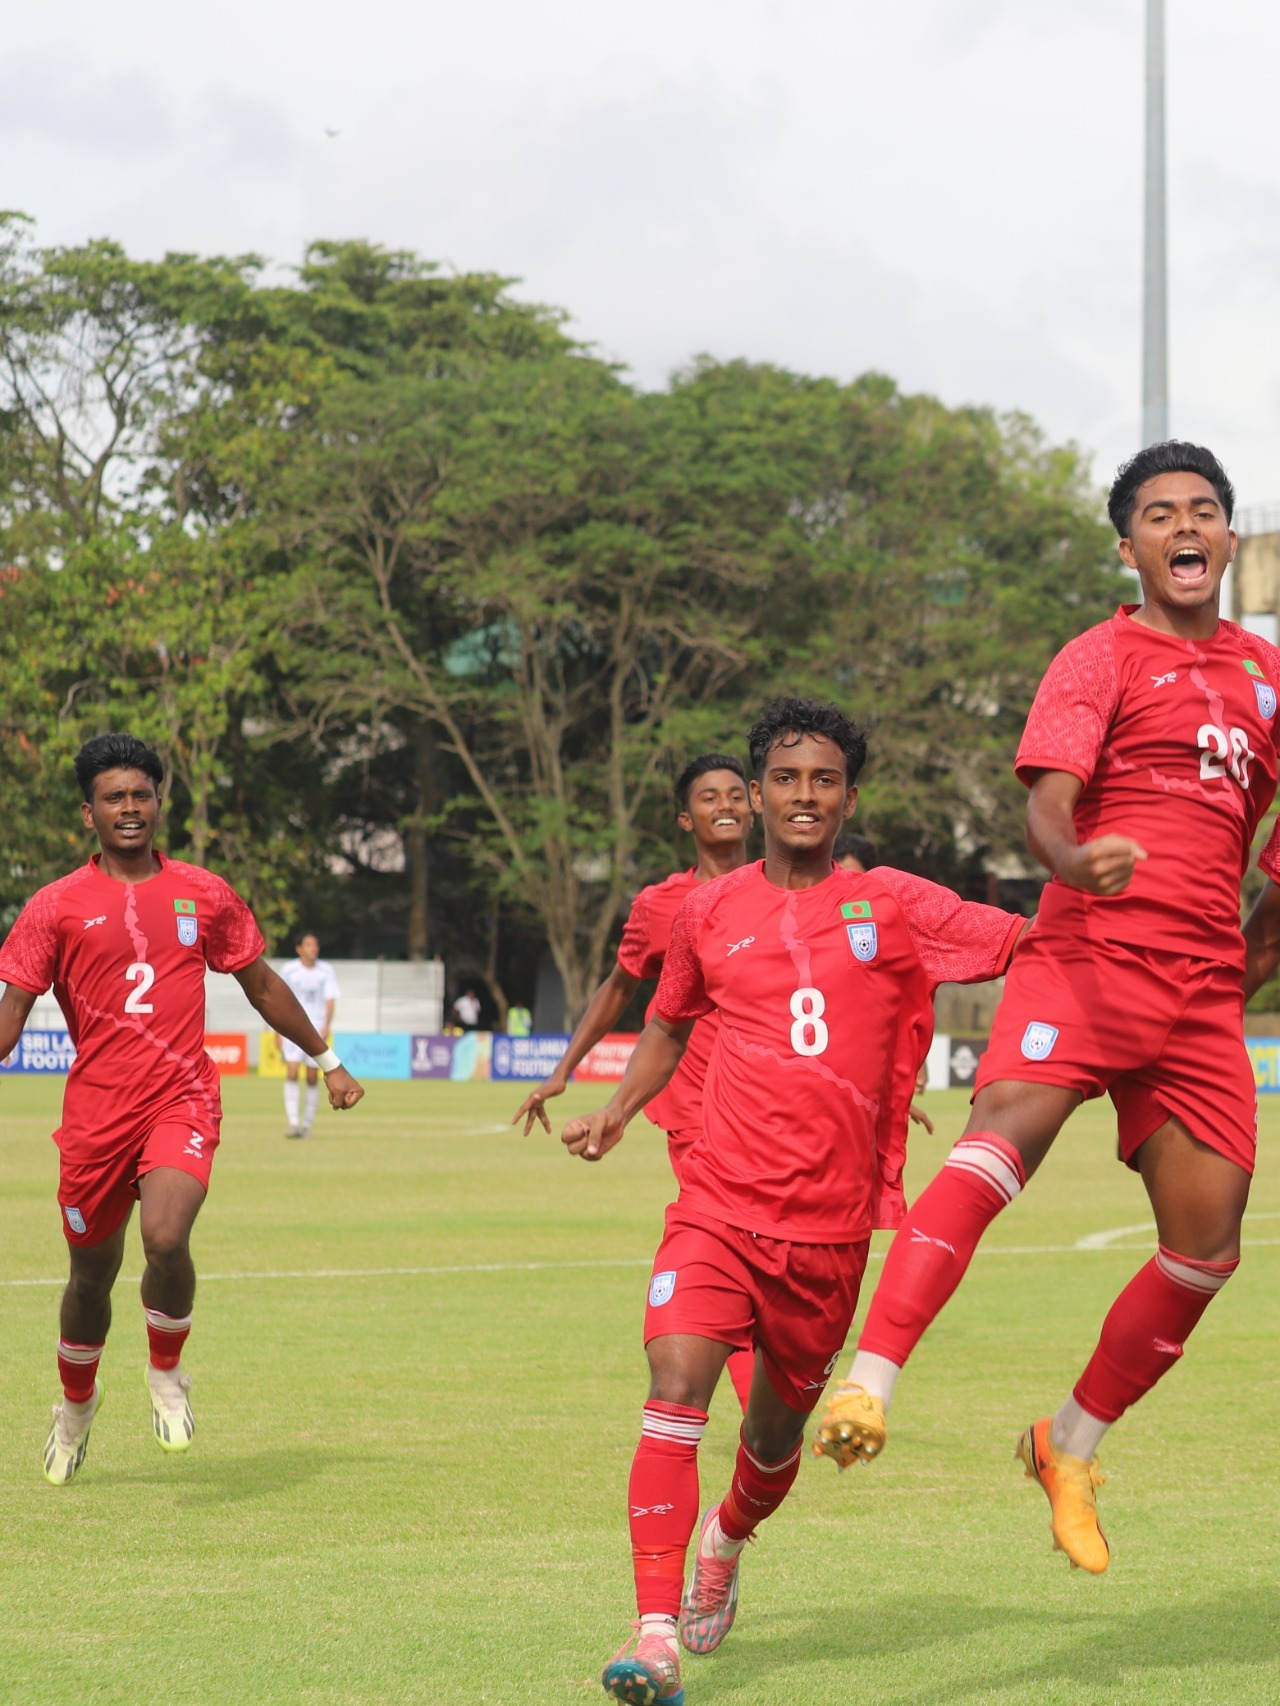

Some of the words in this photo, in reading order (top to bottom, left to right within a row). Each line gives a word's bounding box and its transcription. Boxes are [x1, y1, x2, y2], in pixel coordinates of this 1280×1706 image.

[1197, 724, 1255, 790] 20
[125, 963, 155, 1014] 2
[22, 1033, 50, 1051] SRI
[789, 988, 829, 1057] 8
[189, 1130, 204, 1150] 2
